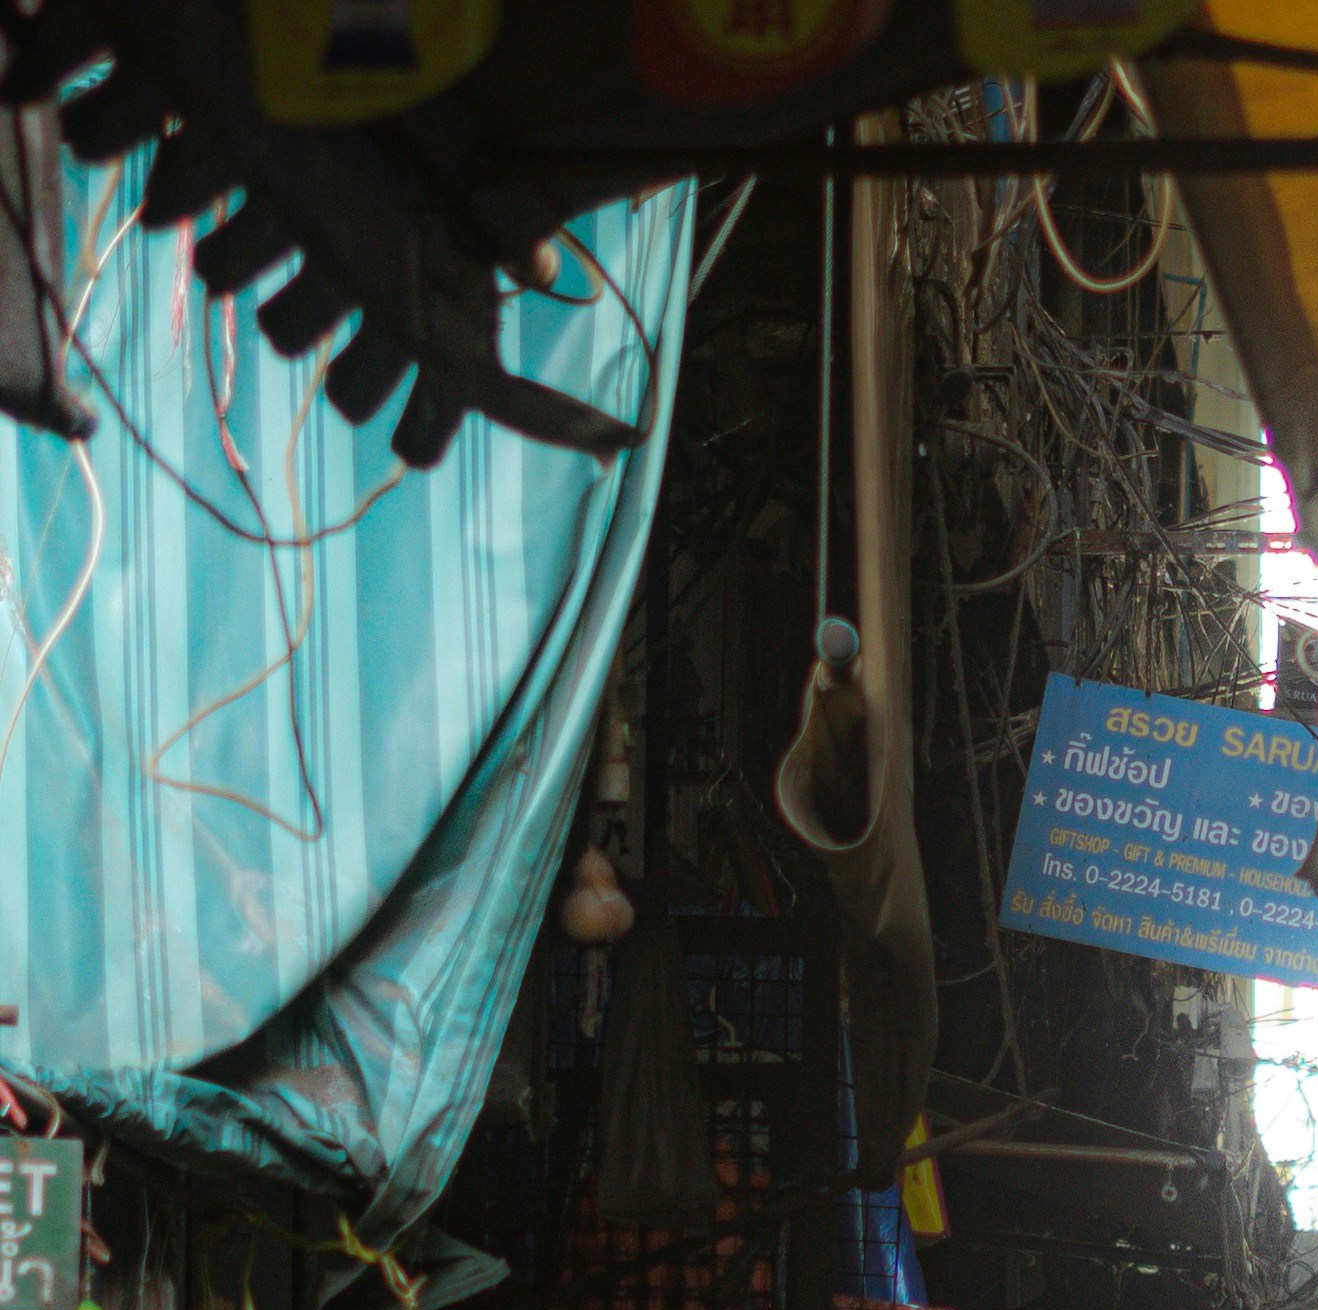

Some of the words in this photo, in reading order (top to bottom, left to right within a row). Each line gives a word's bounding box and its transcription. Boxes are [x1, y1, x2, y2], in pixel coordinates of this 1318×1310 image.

[1105, 706, 1199, 748] สรวย
[1055, 787, 1183, 842] ของขวัญ
[1193, 817, 1241, 846] และ
[1050, 828, 1110, 854] GIFTSHOP
[1124, 843, 1151, 863] GIFT
[1168, 852, 1227, 880] PREMIUM
